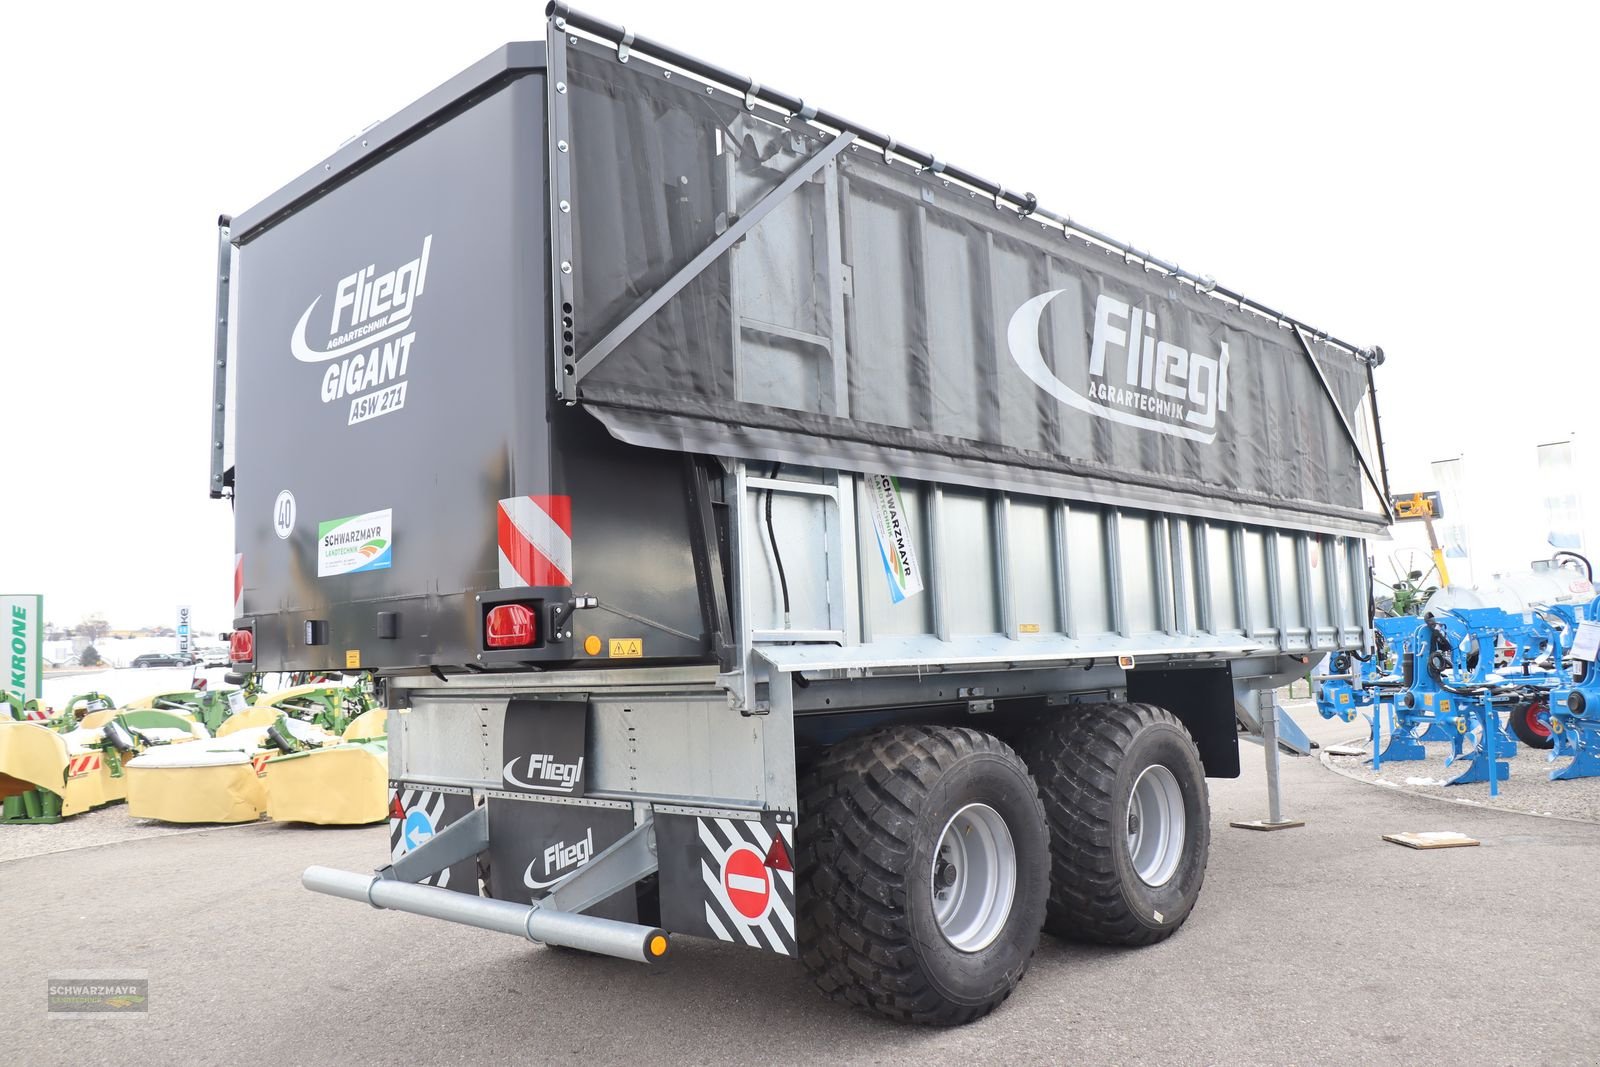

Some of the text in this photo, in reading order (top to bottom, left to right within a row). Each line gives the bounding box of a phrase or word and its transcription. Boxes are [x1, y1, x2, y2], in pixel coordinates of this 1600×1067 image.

[330, 234, 432, 335] Fliegl
[327, 315, 389, 350] AGRARTECHNIK
[321, 332, 416, 403] GIGANT
[1089, 294, 1230, 428] Fliegl
[351, 386, 402, 421] ASW 271
[1088, 381, 1184, 420] AGRARTECHNIK
[278, 499, 291, 529] 40
[324, 526, 381, 547] SCHWARZMAYR
[11, 605, 26, 688] KRONE
[527, 754, 584, 787] Fliegl
[544, 827, 594, 876] Fliegl
